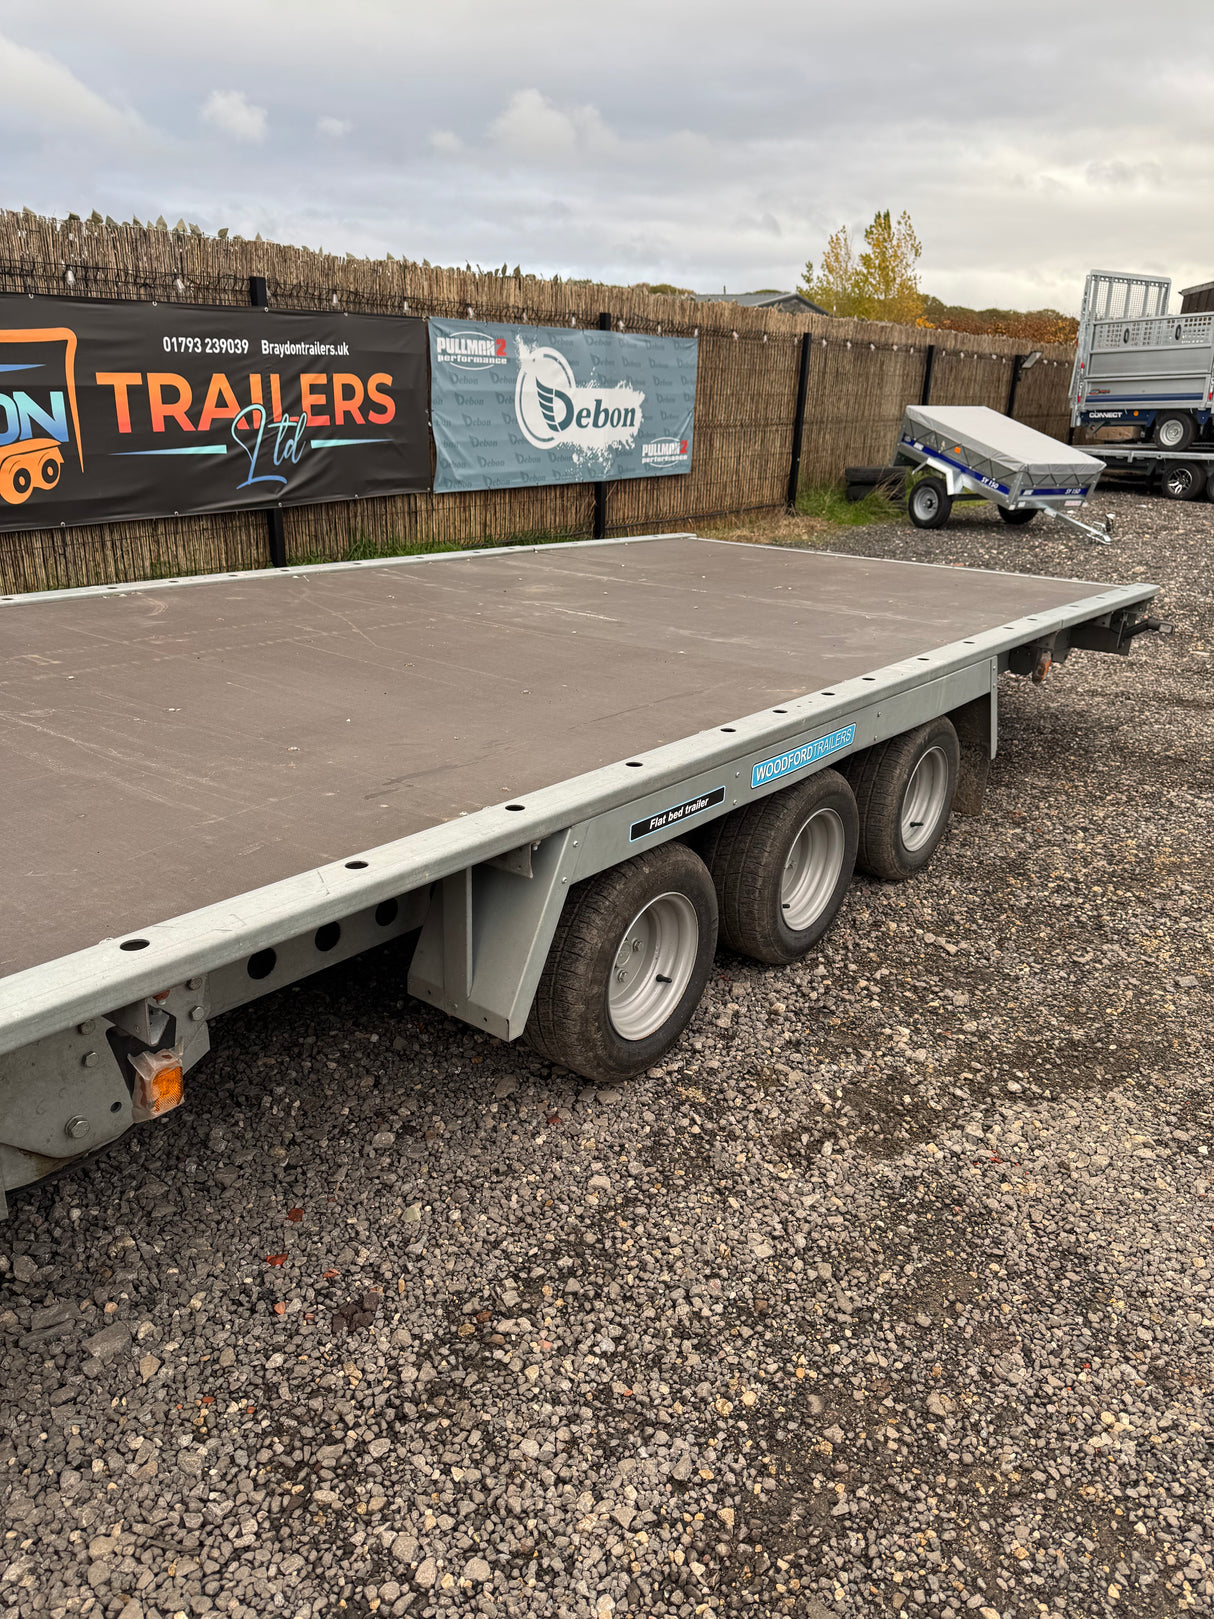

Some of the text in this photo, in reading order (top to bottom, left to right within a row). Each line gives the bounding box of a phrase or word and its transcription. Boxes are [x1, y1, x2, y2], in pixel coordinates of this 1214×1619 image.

[162, 336, 350, 357] 01793 239039 Braydontrailers.uk
[437, 355, 507, 364] performance
[96, 372, 397, 434] TRAILERS
[535, 376, 636, 433] Debon
[1088, 411, 1123, 419] CONNECT
[230, 403, 308, 490] Ltd
[649, 796, 710, 830] Flat bed trailer
